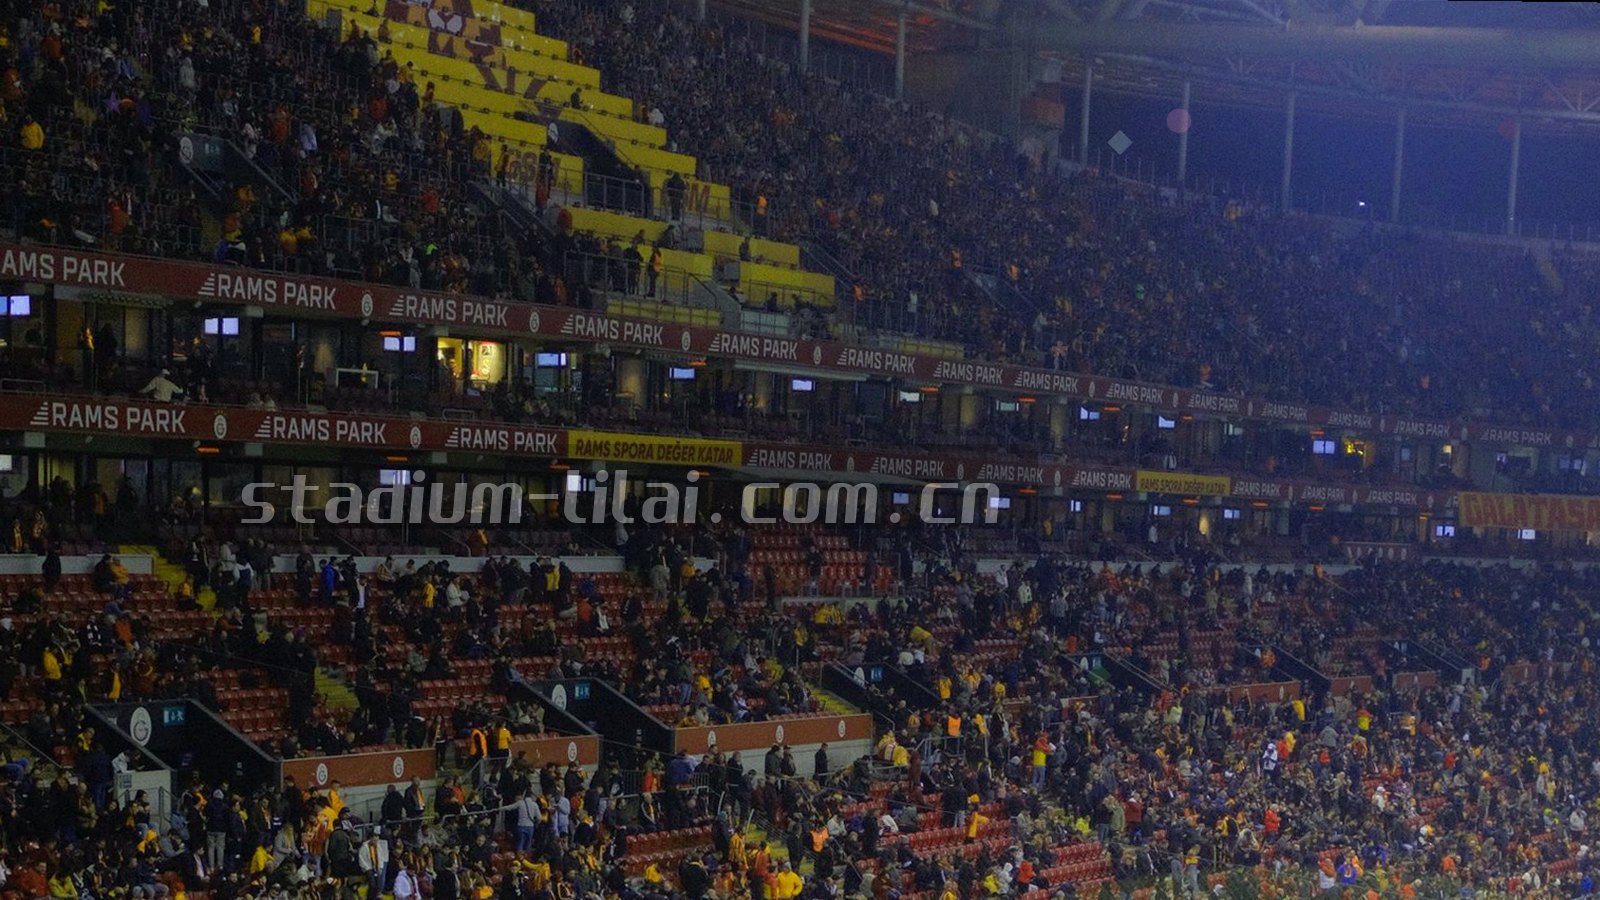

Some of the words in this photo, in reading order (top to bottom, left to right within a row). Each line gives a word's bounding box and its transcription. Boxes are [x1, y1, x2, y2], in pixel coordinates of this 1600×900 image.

[63, 256, 125, 287] PARK
[218, 273, 277, 302] RAMS
[284, 282, 337, 310] PARK
[406, 297, 457, 321] RAMS
[462, 301, 508, 327] PARK
[575, 316, 619, 340] RAMS
[624, 322, 663, 345] PARK
[721, 333, 760, 356] RAMS
[763, 339, 798, 361] PARK
[848, 349, 882, 369] RAMS
[885, 353, 915, 374] PARK
[942, 361, 973, 382] RAMS
[975, 364, 1003, 385] PARK
[1022, 371, 1051, 390] RAMS
[1053, 375, 1078, 394] PARK
[1113, 383, 1139, 401] RAMS
[1140, 386, 1164, 404] PARK
[1195, 393, 1217, 410] RAMS
[1218, 396, 1240, 412] PARK
[1268, 403, 1288, 419] RAMS
[1289, 405, 1308, 421] PARK
[52, 402, 118, 429] RAMS
[127, 407, 185, 433] PARK
[1333, 411, 1352, 426] RAMS
[1353, 413, 1373, 429] PARK
[1400, 420, 1424, 436] RAMS
[1425, 422, 1450, 437] PARK
[273, 416, 330, 441] RAMS
[336, 420, 386, 444] PARK
[460, 427, 508, 450] RAMS
[514, 431, 557, 454] PARK
[1489, 429, 1520, 444] RAMS
[1522, 430, 1551, 446] PARK
[575, 438, 611, 458] RAMS
[613, 441, 654, 461] SPORA
[656, 440, 696, 463] DEĞER
[698, 446, 733, 464] KATAR
[758, 449, 796, 468] RAMS
[799, 452, 831, 470] PARK
[879, 458, 912, 477] RAMS
[914, 459, 944, 477] PARK
[986, 464, 1015, 481] RAMS
[1017, 466, 1043, 483] PARK
[1080, 470, 1106, 487] RAMS
[1107, 472, 1131, 489] PARK
[1239, 481, 1260, 496] RAMS
[1261, 482, 1281, 497] PARK
